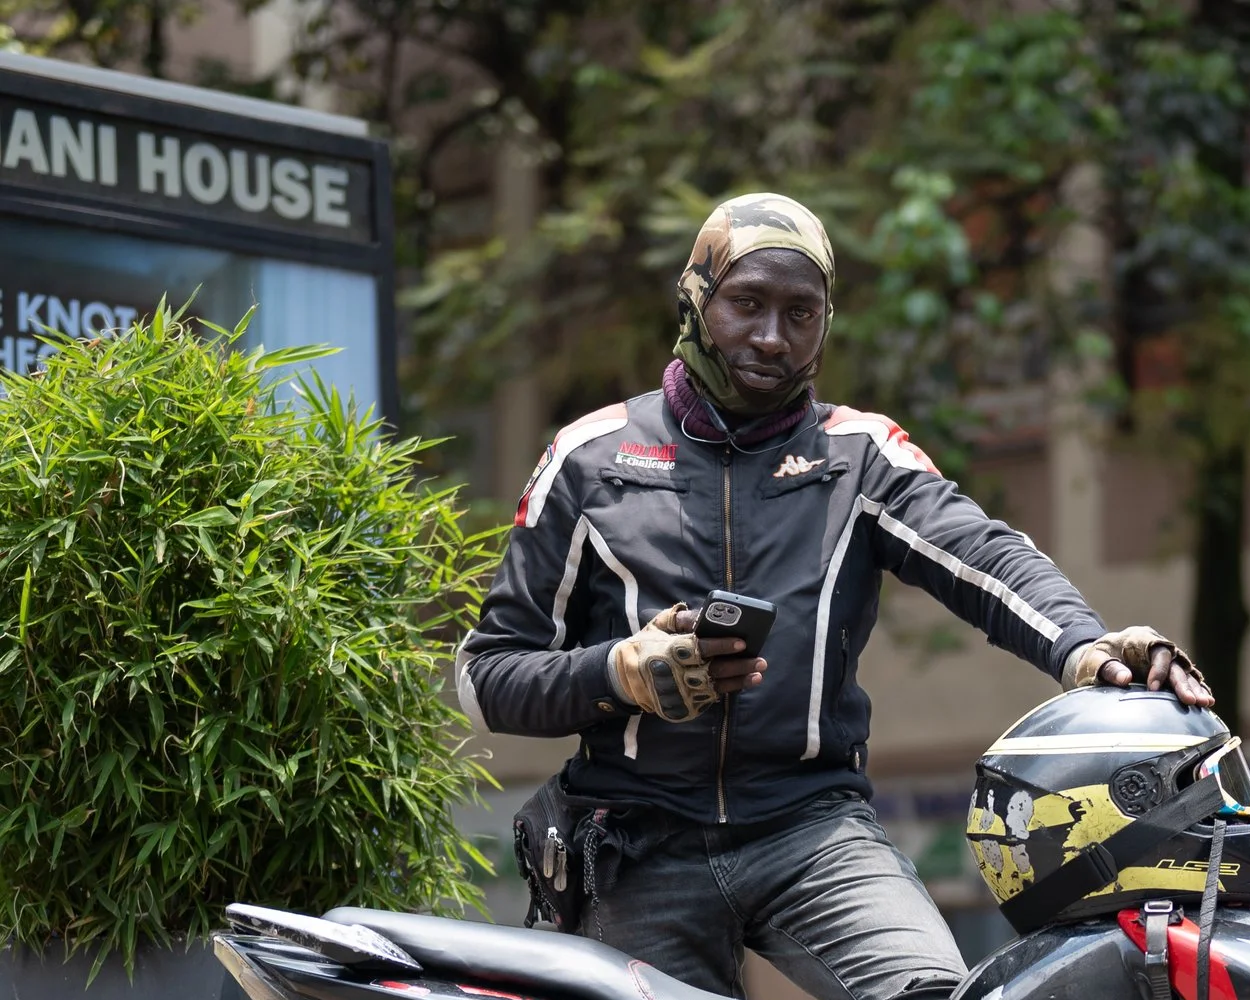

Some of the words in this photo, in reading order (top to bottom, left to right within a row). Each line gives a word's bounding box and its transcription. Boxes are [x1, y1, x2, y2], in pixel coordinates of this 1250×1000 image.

[0, 109, 118, 186] ANI
[137, 131, 350, 228] HOUSE
[17, 291, 138, 343] KNOT
[615, 453, 675, 470] K-Challenge
[1156, 859, 1240, 876] LS2
